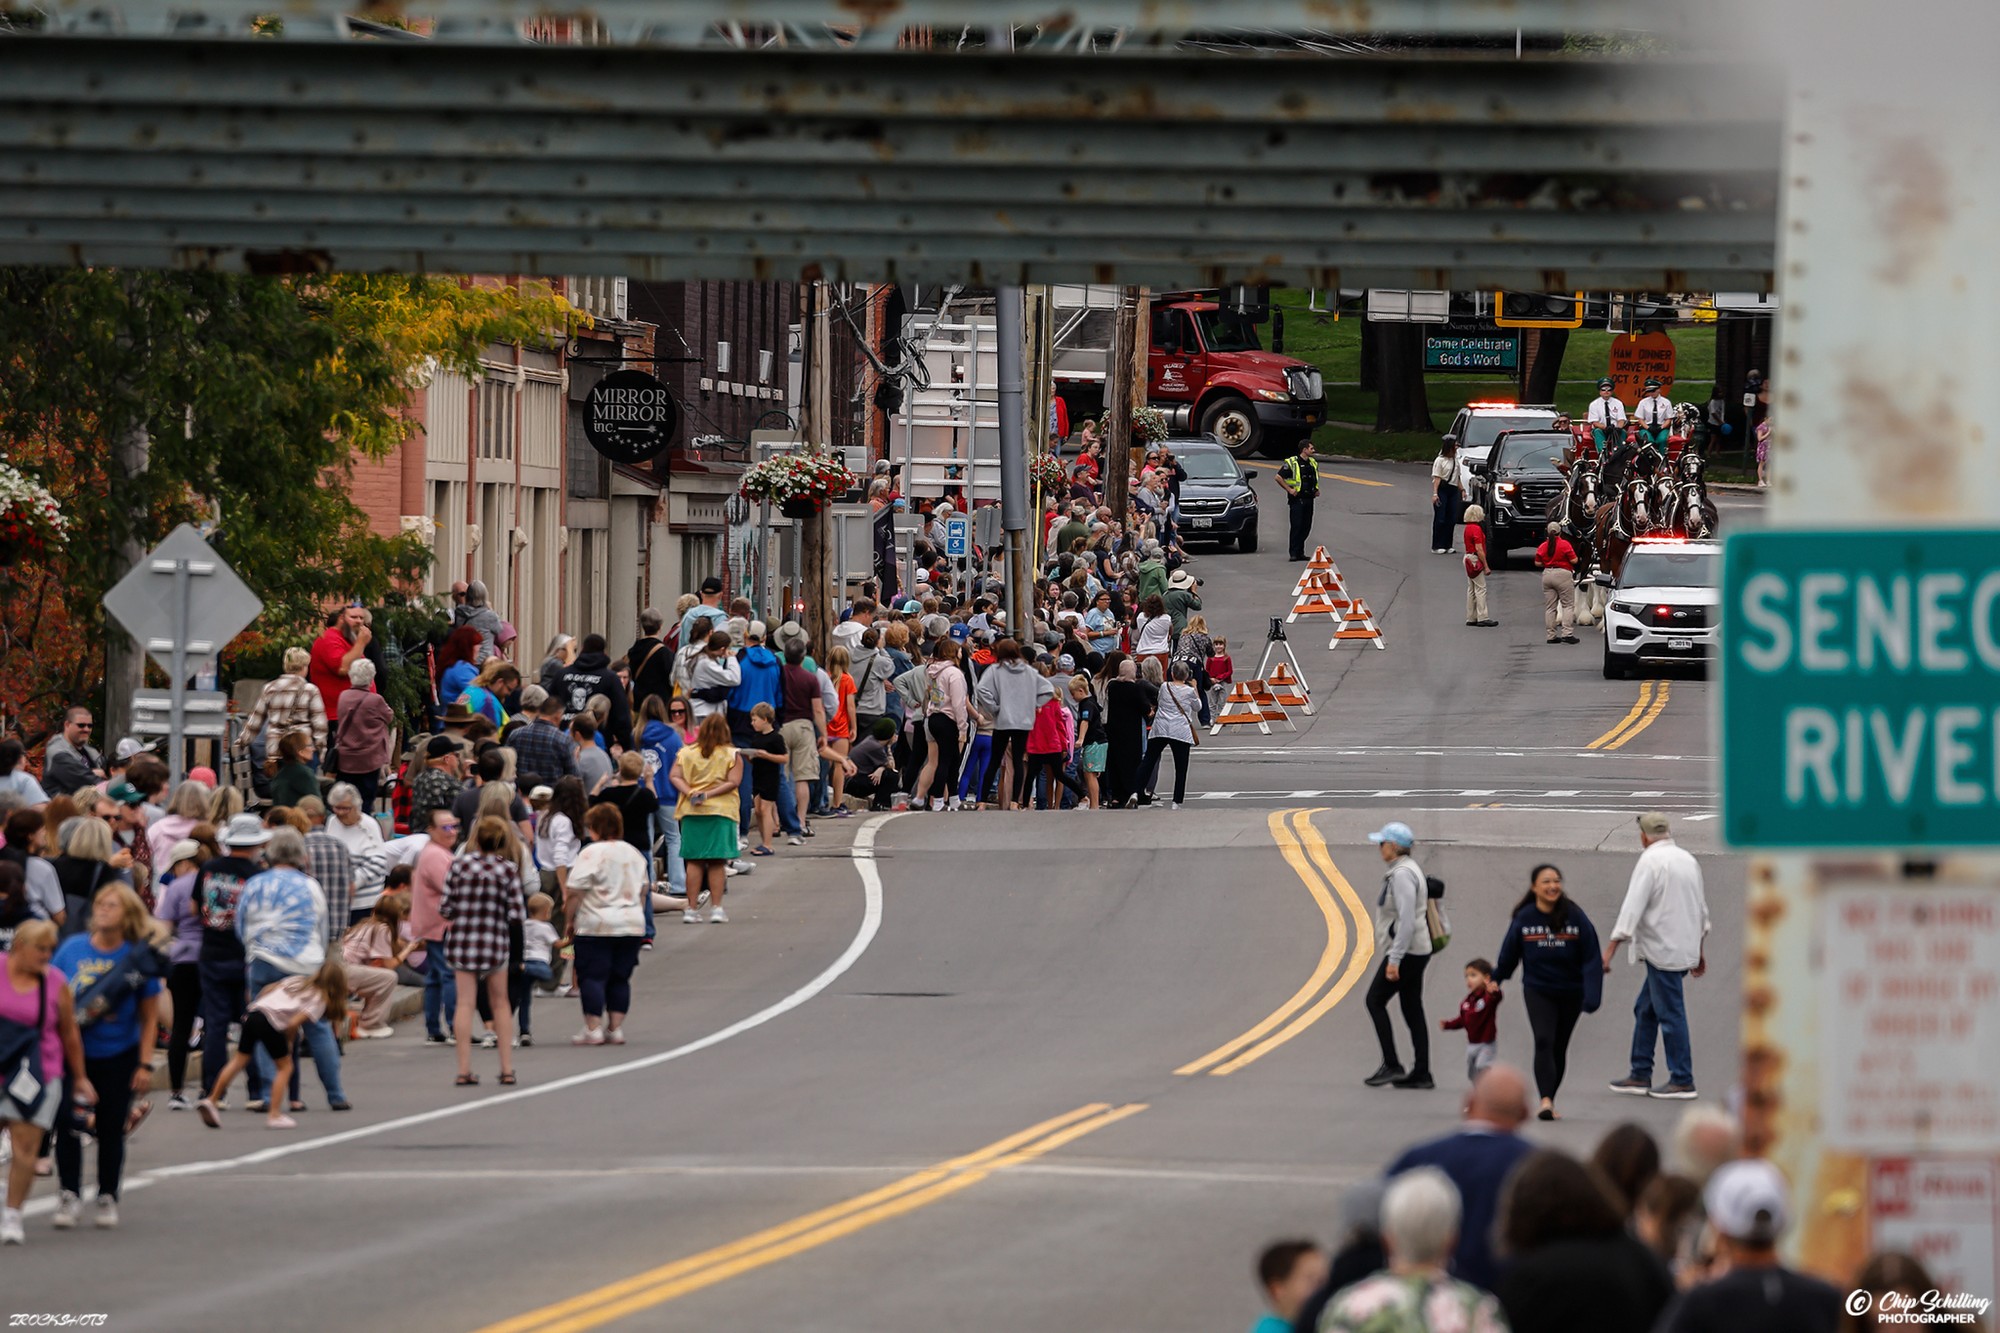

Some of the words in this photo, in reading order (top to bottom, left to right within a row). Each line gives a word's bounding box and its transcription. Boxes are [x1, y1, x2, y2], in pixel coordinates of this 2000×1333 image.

[1448, 321, 1477, 333] Nursery
[1427, 337, 1458, 349] Come
[1461, 337, 1512, 351] Celebrate
[1440, 352, 1470, 366] God's
[1472, 353, 1501, 366] Word
[1613, 348, 1632, 359] HAM
[1639, 349, 1673, 360] DINNER
[1616, 361, 1670, 373] DRIVE-THRU
[1612, 373, 1629, 385] OCT
[1633, 374, 1639, 385] 3
[593, 387, 667, 405] MIRROR
[593, 404, 667, 421] MIRROR
[593, 420, 616, 433] inc.
[1784, 705, 2000, 804] RIVE
